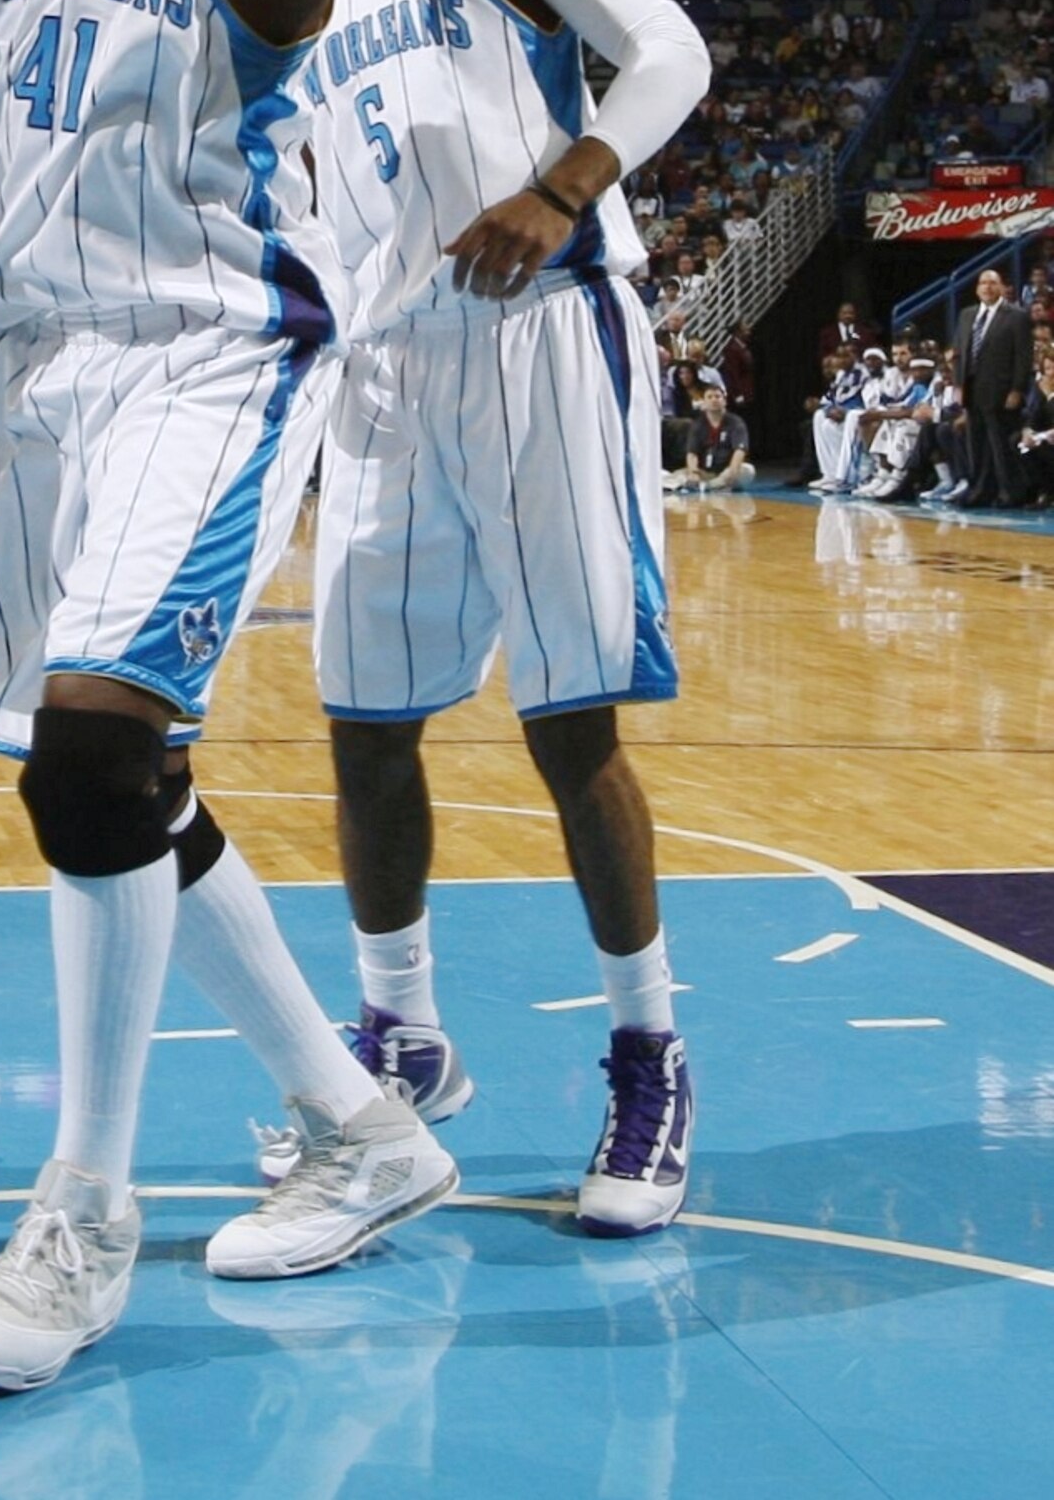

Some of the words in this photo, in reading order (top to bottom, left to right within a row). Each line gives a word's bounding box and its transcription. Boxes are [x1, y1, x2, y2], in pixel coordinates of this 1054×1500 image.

[13, 14, 99, 133] 41
[354, 83, 400, 184] 5
[943, 166, 1009, 176] EMERGENCY
[964, 175, 988, 186] EXIT
[870, 192, 1037, 240] Budweiser
